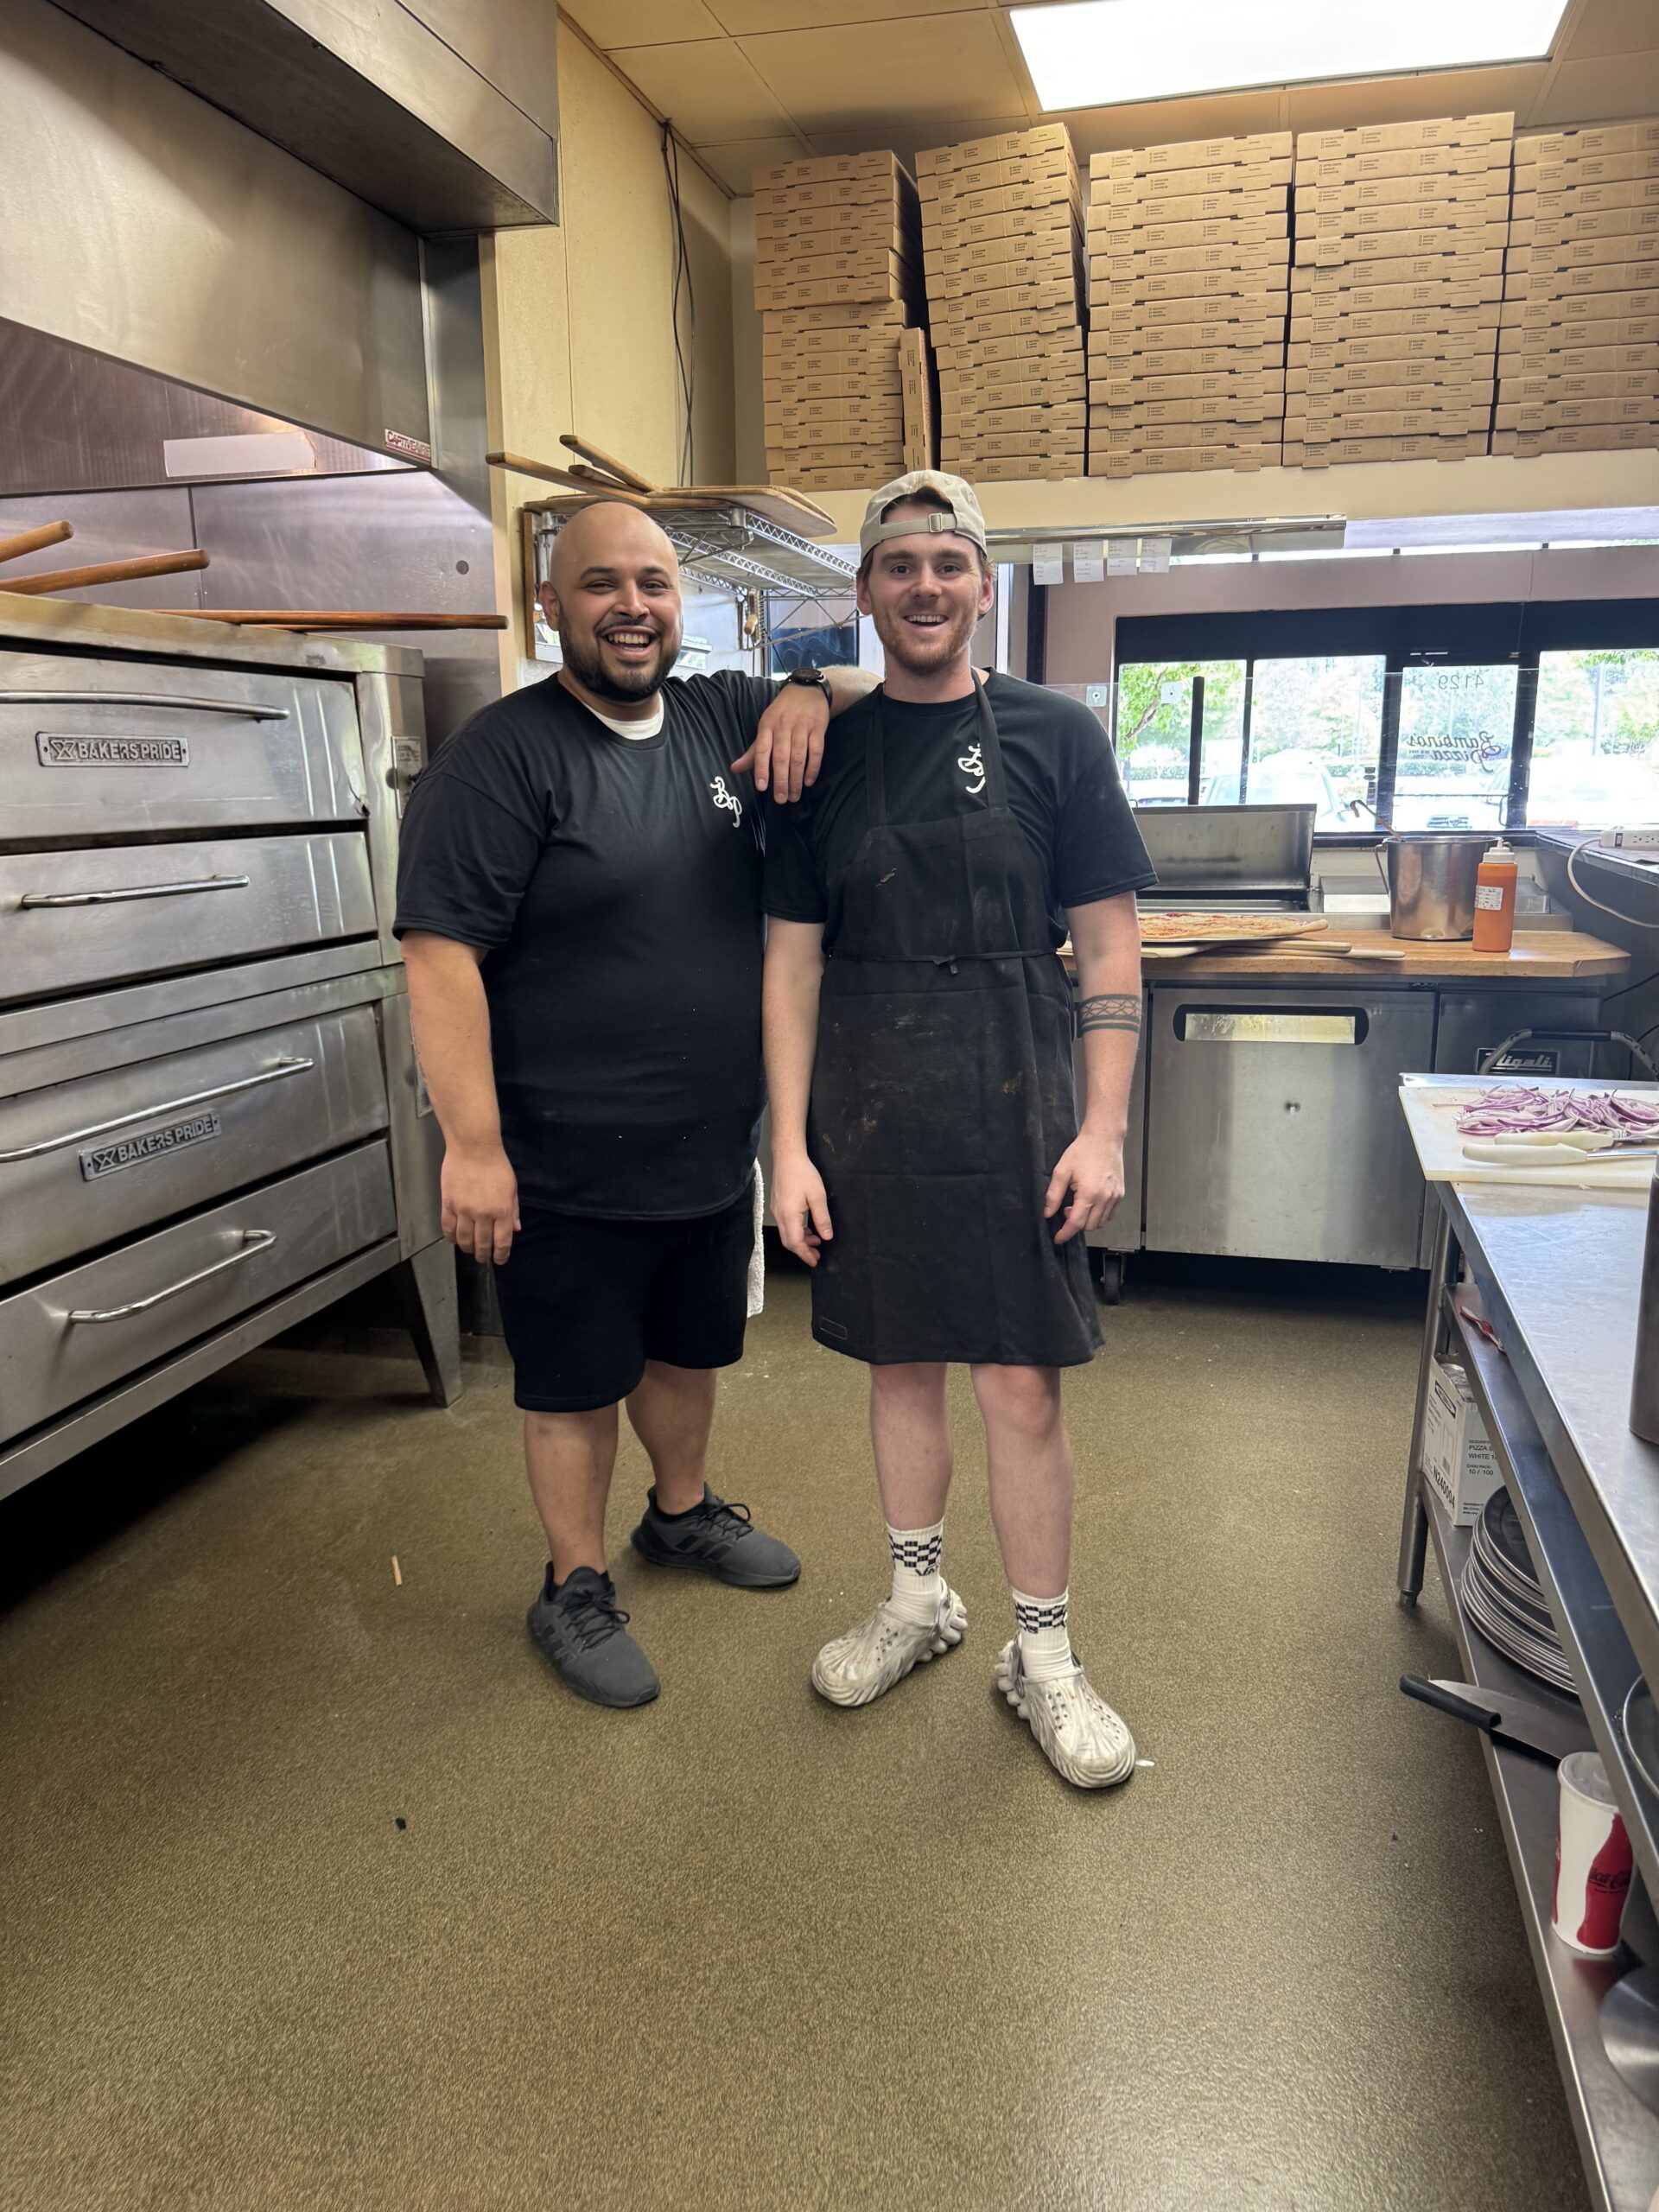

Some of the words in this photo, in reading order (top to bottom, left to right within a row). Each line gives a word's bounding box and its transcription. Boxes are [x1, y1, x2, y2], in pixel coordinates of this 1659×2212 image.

[78, 742, 139, 760] BAKERS
[140, 743, 181, 760] PRIDE
[118, 1130, 174, 1163] BAKERS
[175, 1117, 213, 1143] PRIDE
